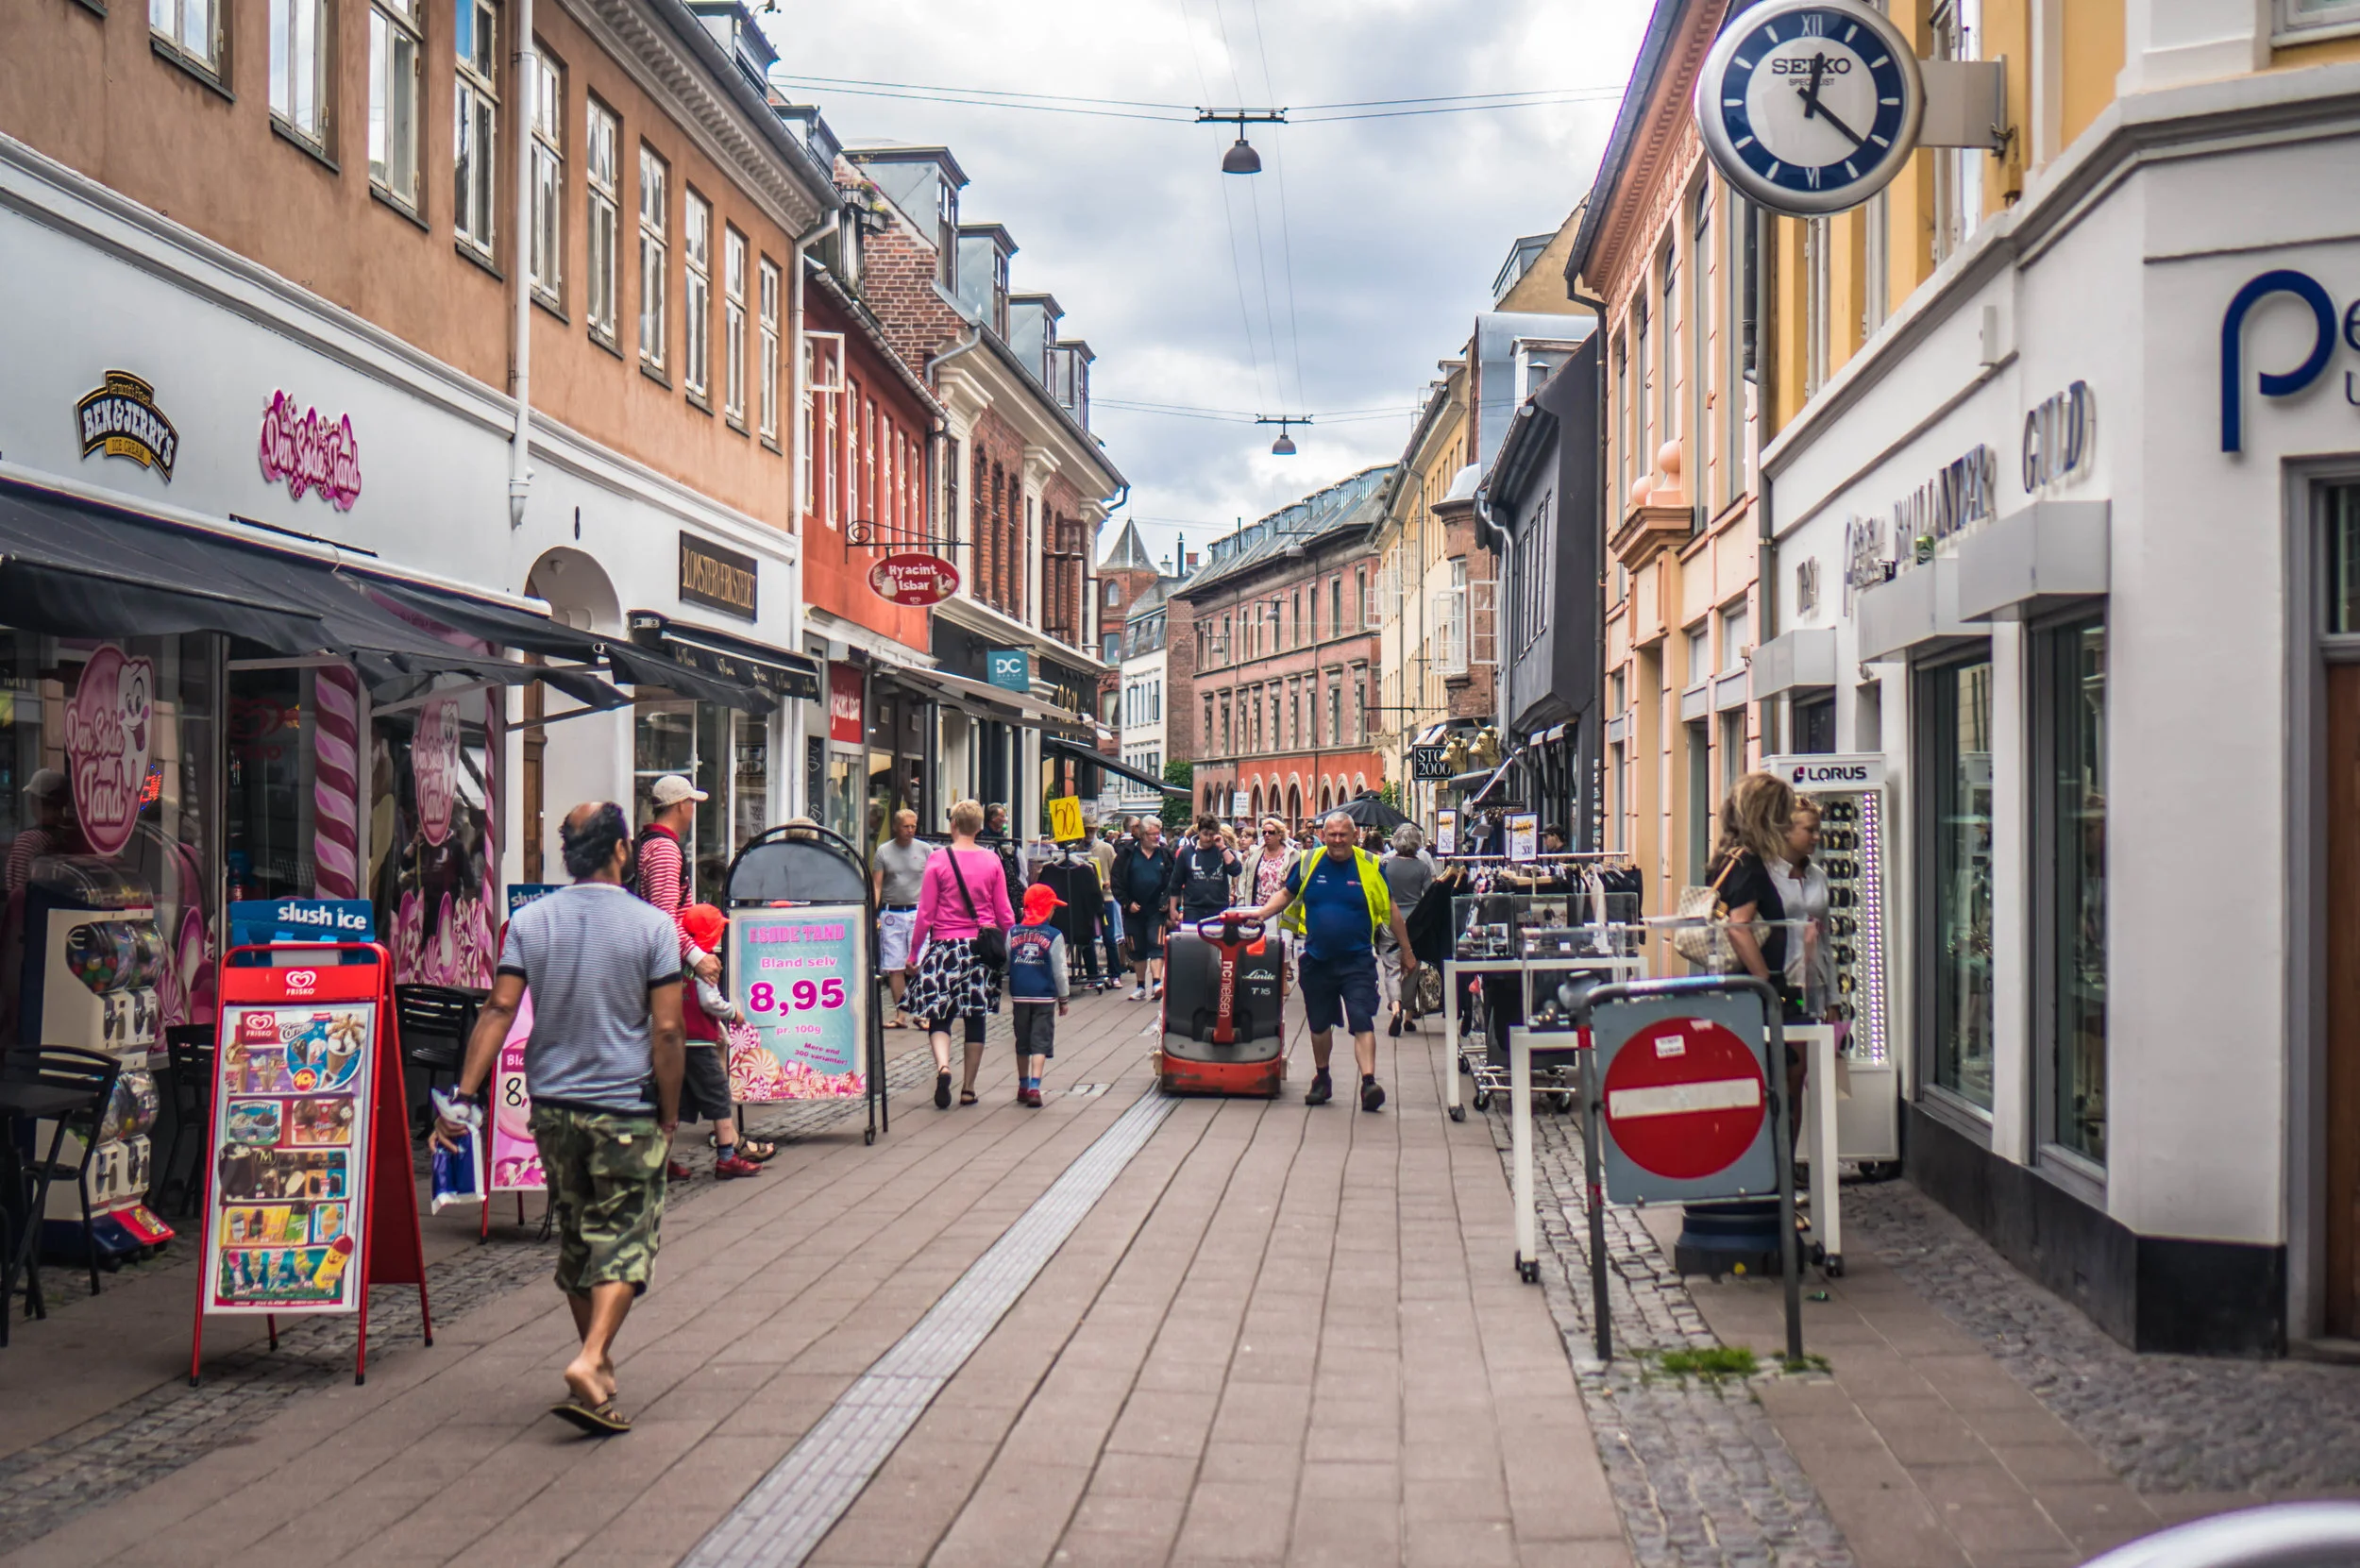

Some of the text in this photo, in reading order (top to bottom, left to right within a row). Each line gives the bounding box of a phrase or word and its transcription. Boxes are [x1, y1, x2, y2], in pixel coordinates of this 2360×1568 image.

[328, 433, 360, 494] Tand
[888, 564, 938, 579] Hyacint
[899, 580, 930, 592] Isbar
[996, 658, 1021, 674] DC
[65, 705, 93, 753] Den
[1418, 749, 1445, 763] STO
[1418, 762, 1452, 775] 2000
[1809, 767, 1867, 781] LORUS
[79, 758, 125, 824] Tand
[1054, 802, 1076, 837] 50
[278, 902, 367, 931] slush ice
[802, 923, 845, 942] TAND
[761, 955, 838, 969] Bland selv
[1242, 969, 1275, 981] Linde
[286, 987, 316, 996] FRISKO
[749, 978, 846, 1017] 8,95
[776, 1024, 821, 1036] pr. 100g
[795, 1049, 809, 1057] 300
[804, 1042, 824, 1052] Mere
